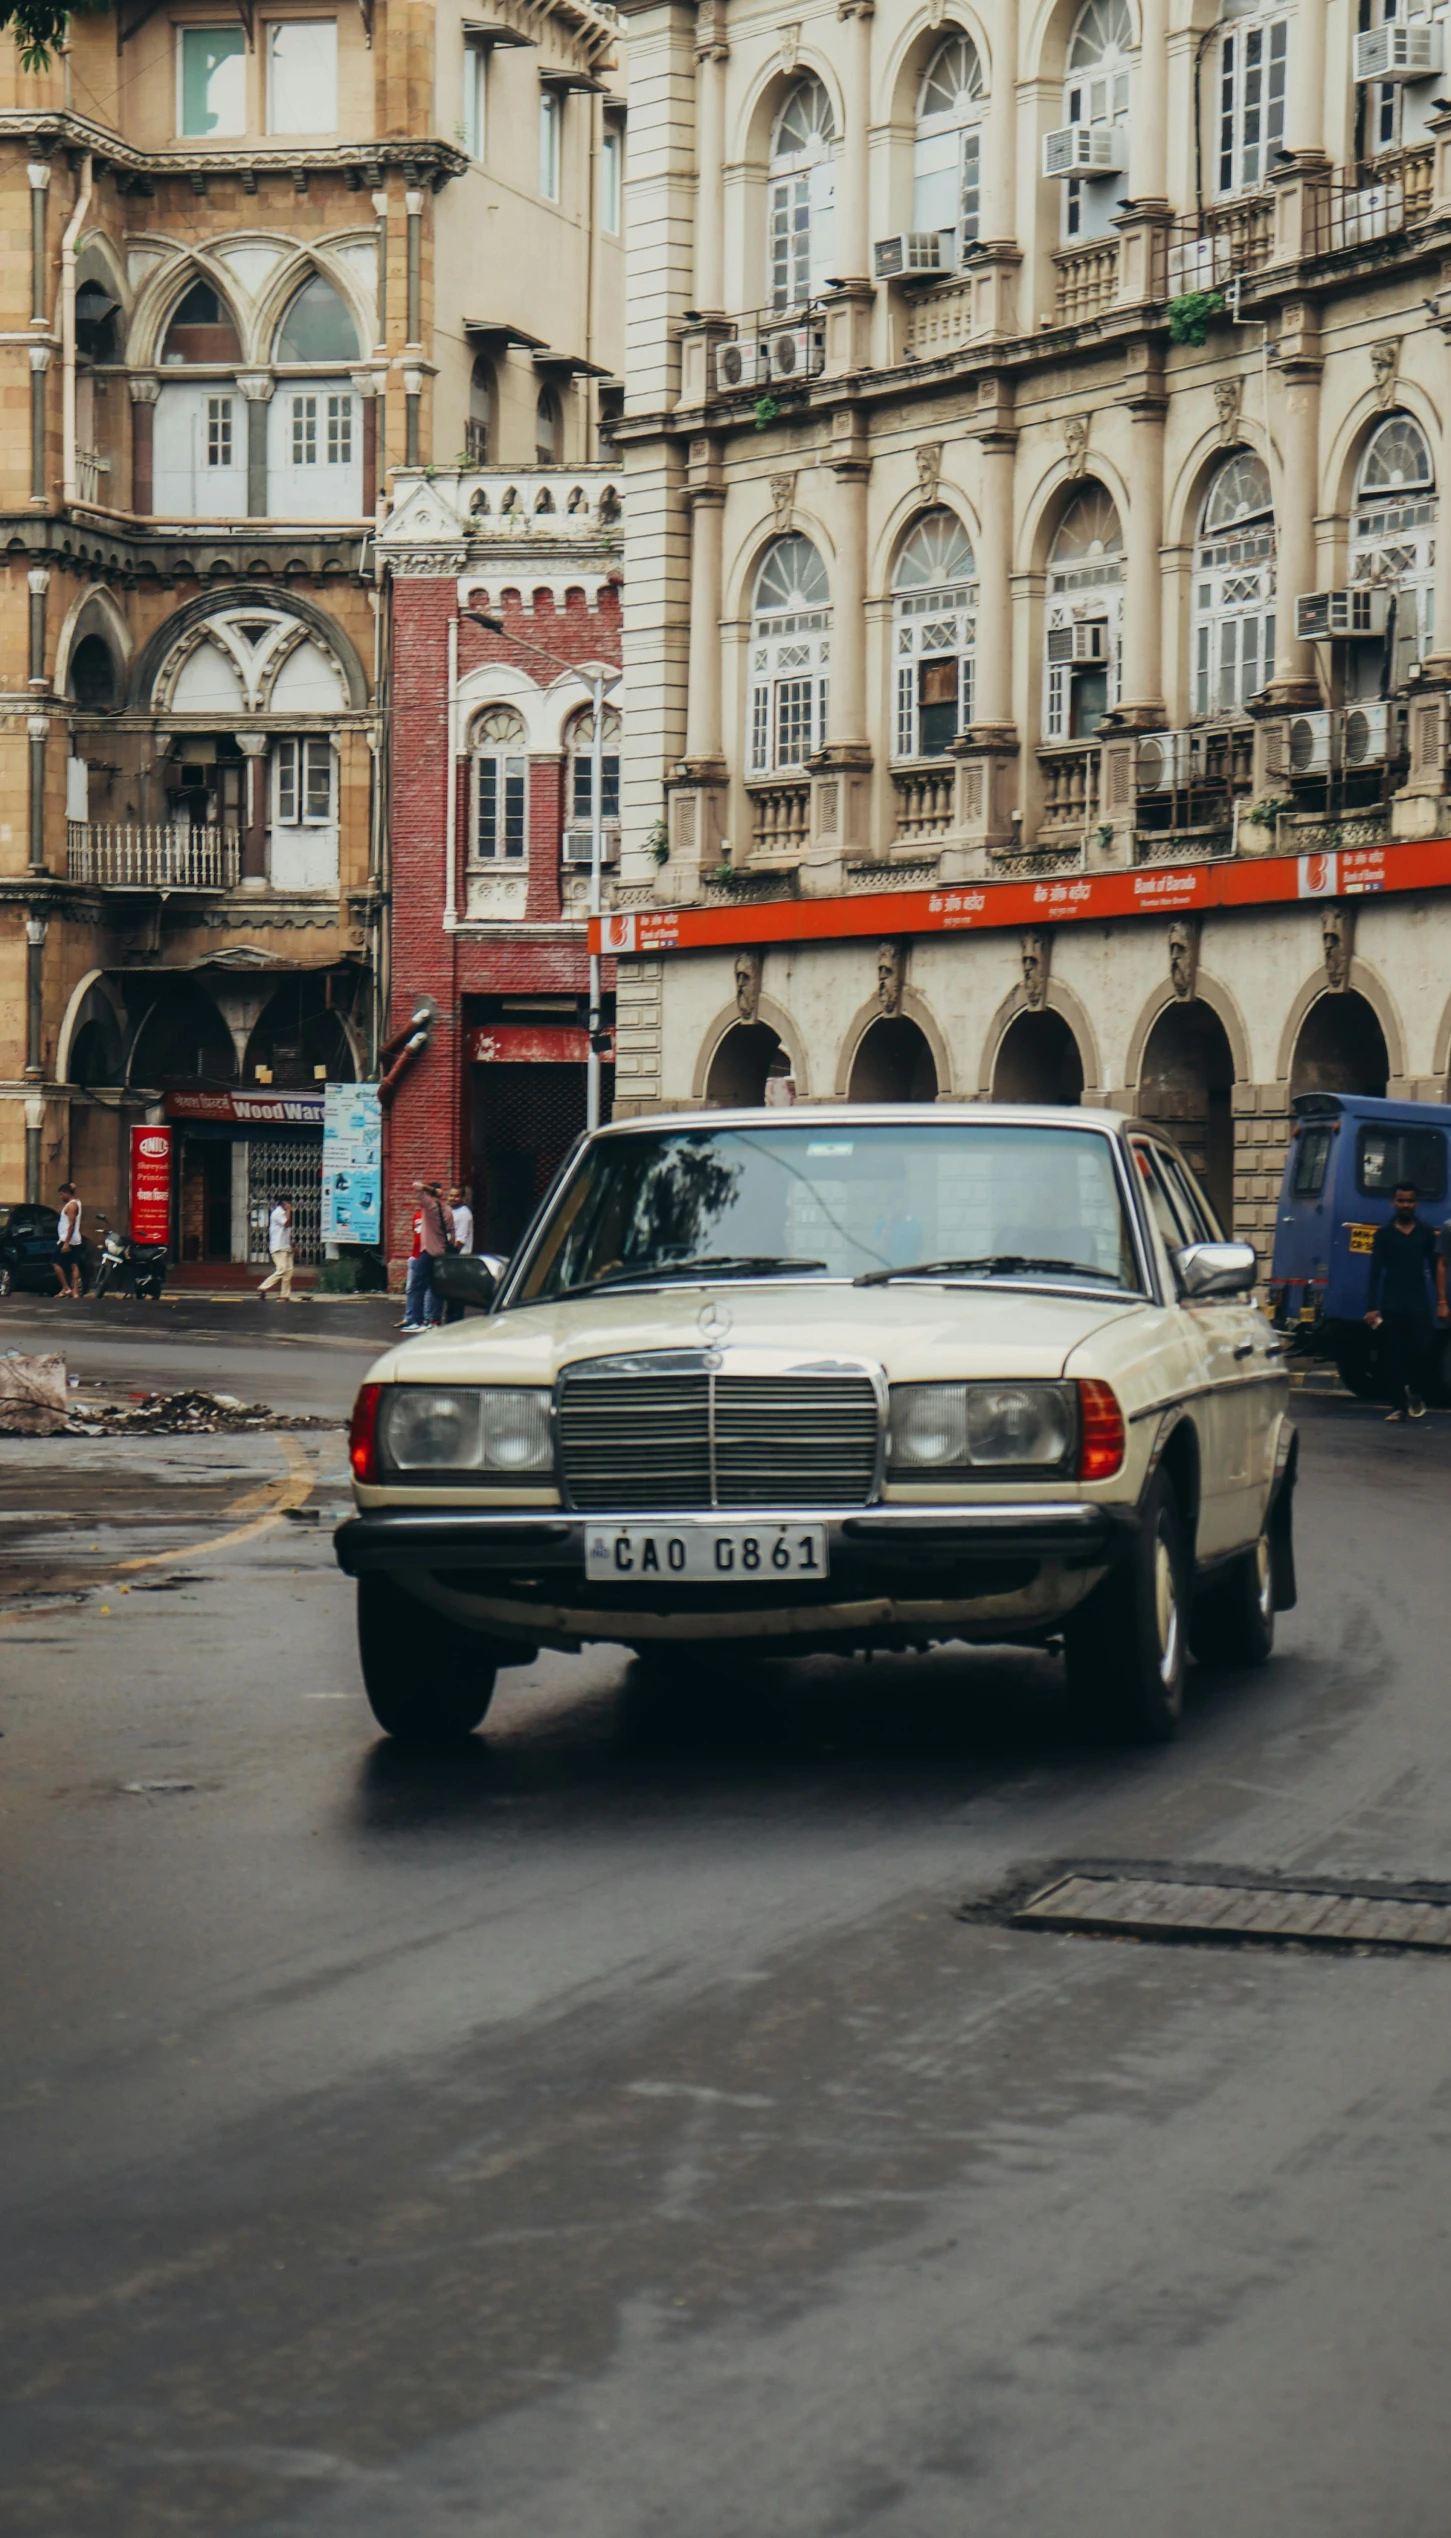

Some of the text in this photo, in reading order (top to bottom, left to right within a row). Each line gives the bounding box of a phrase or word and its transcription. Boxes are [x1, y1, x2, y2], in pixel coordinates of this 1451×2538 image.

[1134, 873, 1196, 894] Bank of Baroda
